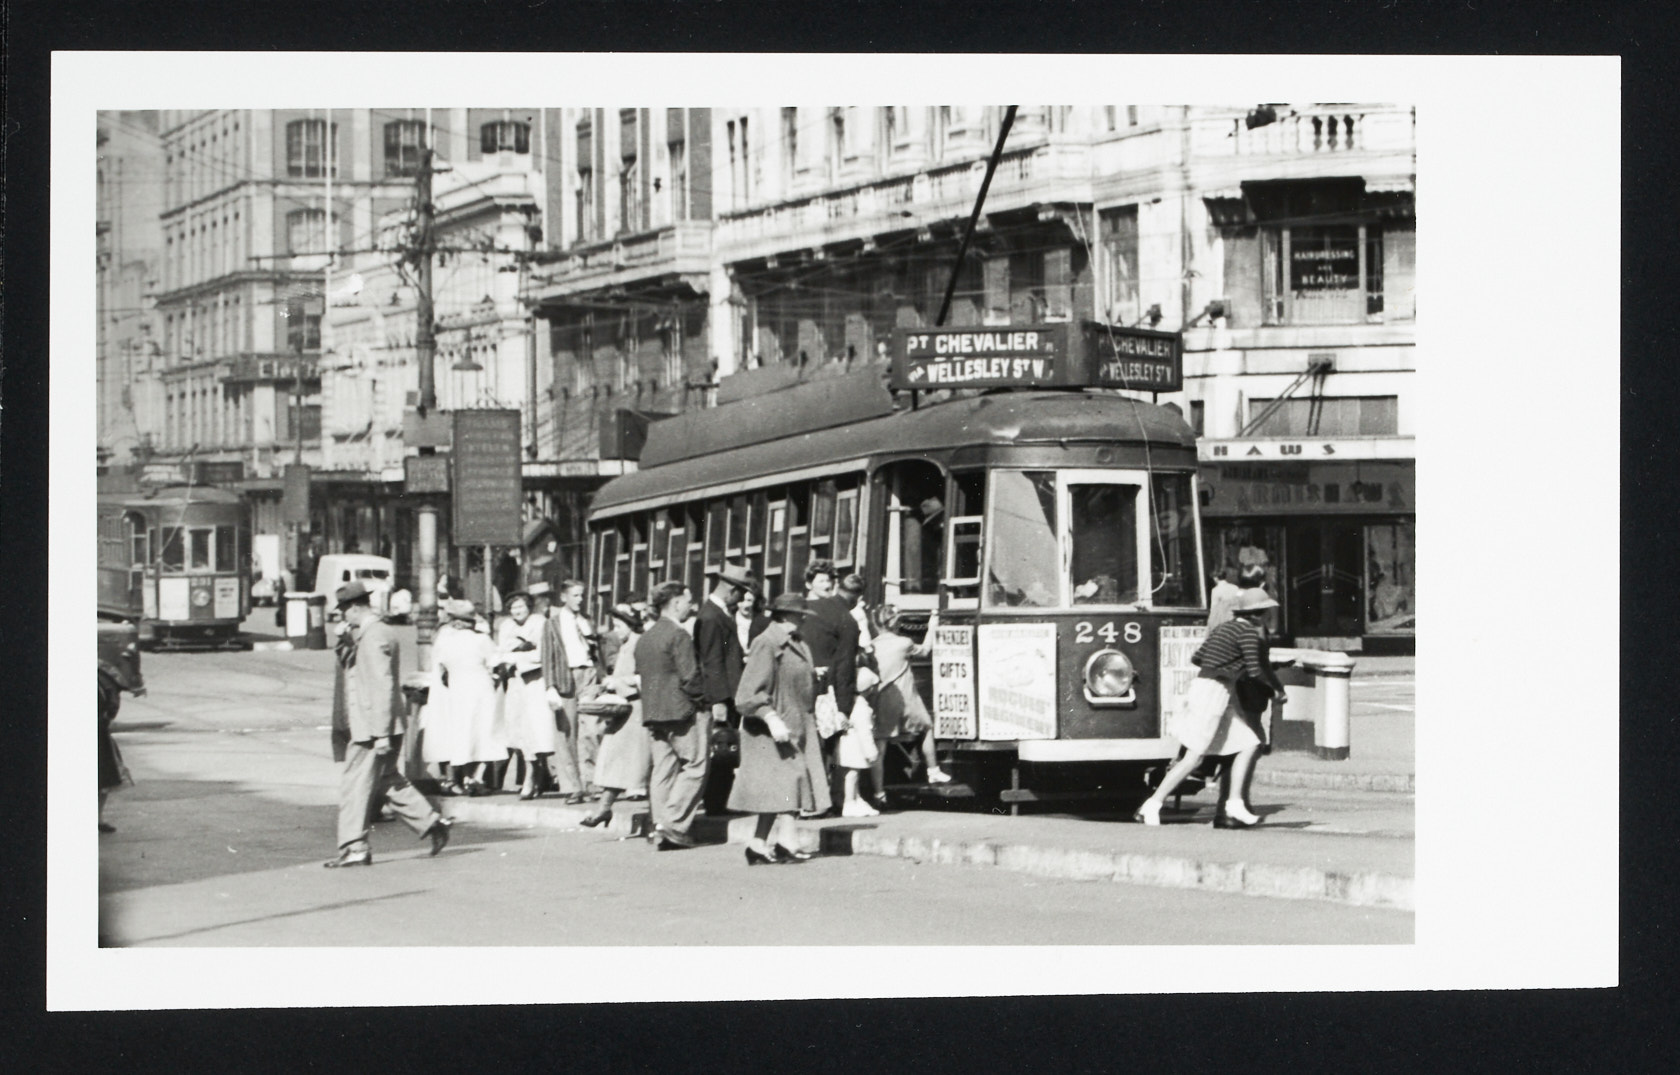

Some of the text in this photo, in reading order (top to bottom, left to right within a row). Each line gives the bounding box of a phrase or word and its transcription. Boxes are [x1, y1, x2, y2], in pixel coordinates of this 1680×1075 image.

[1294, 249, 1355, 260] HAIRDRESSING
[1302, 274, 1347, 285] BEAUTY
[907, 332, 1039, 354] PT CHEVALIER
[1114, 336, 1171, 357] CHEVALIER
[927, 358, 1010, 382] WELLESLEY
[1033, 359, 1045, 378] W
[1109, 362, 1154, 381] WELLESLEY
[1075, 621, 1142, 644] 248
[940, 662, 967, 678] GIFTS
[939, 693, 969, 712] EASTER
[940, 716, 968, 736] BRIDES
